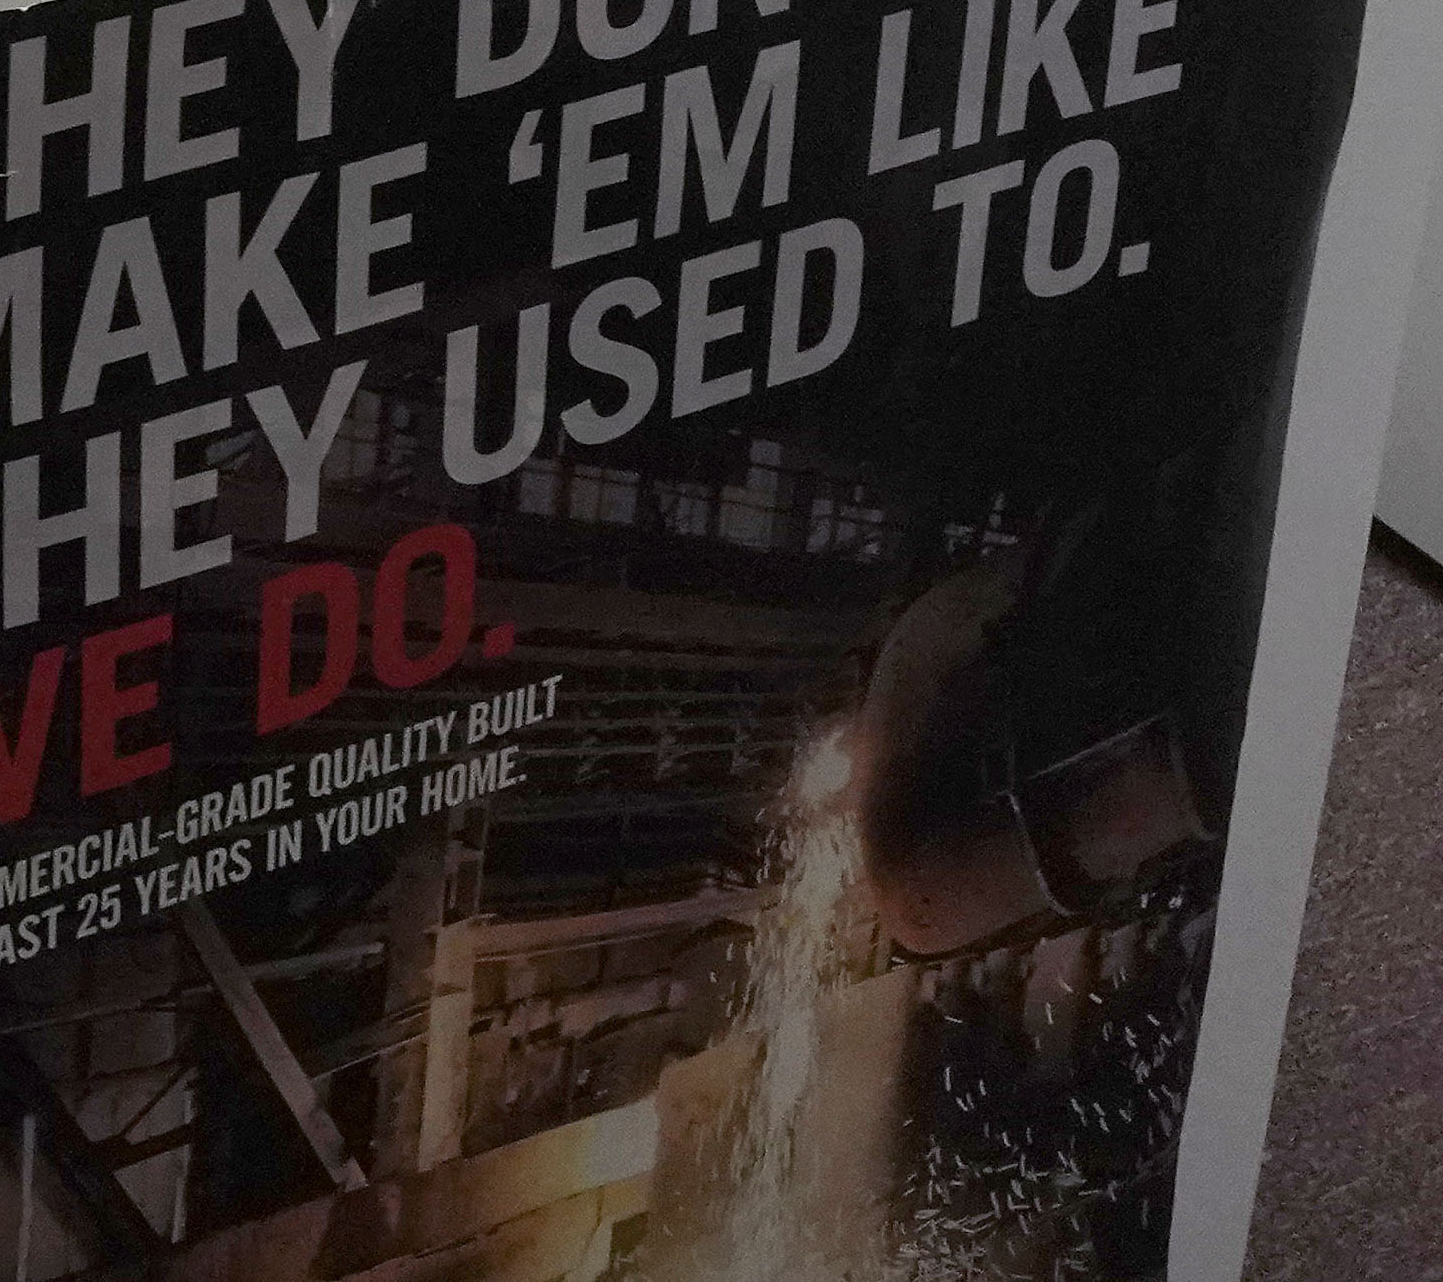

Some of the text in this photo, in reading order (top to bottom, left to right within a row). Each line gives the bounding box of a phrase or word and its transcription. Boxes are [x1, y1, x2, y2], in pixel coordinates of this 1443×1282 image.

[440, 215, 864, 491] USED
[934, 138, 1152, 325] TO.
[256, 521, 516, 737] DO.
[308, 713, 456, 799] QUALITY
[465, 674, 564, 748] BUILT
[75, 886, 124, 940] 25
[133, 839, 254, 920] YEARS
[265, 823, 304, 874] IN
[315, 783, 409, 854] YOUR
[418, 743, 529, 811] HOME.
